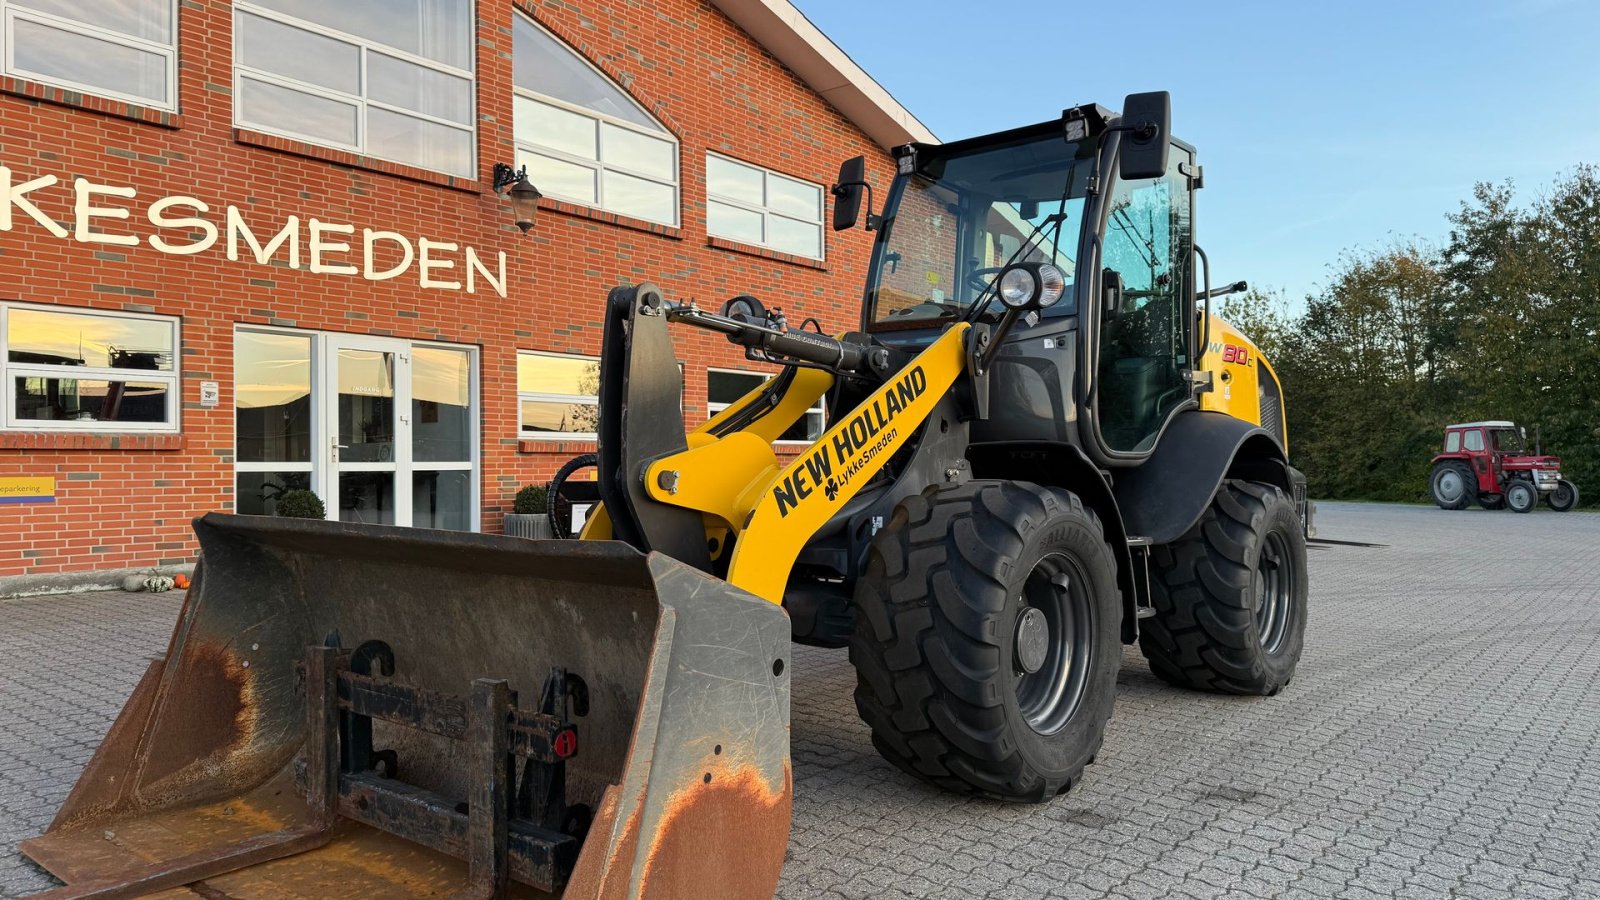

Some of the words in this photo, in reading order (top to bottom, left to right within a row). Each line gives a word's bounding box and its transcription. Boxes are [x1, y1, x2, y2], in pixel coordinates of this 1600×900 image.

[0, 166, 507, 298] KESMEDEN
[772, 444, 832, 518] NEW
[832, 365, 927, 466] HOLLAND
[837, 427, 898, 487] LykkeSmeden
